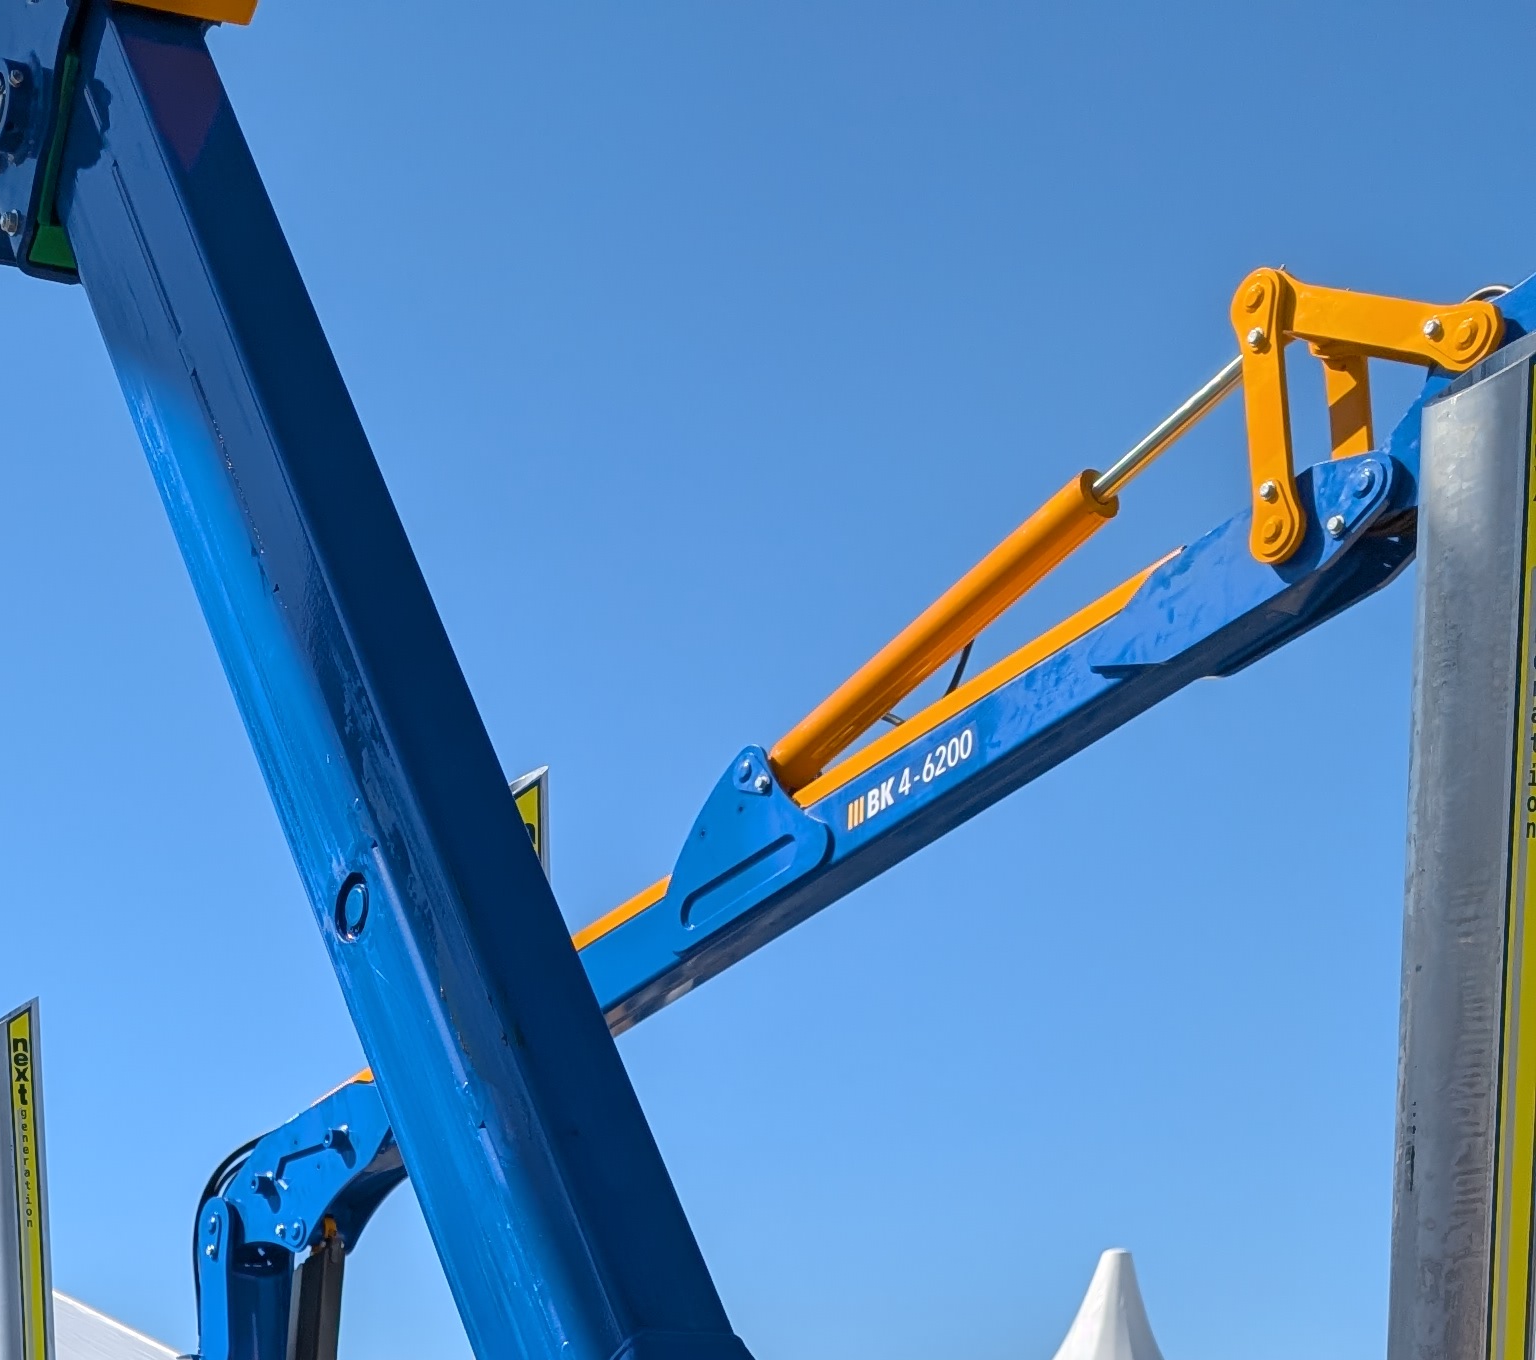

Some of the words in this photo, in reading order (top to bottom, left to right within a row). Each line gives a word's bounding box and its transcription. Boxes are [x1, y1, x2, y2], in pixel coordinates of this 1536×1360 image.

[867, 776, 895, 819] BK
[898, 729, 973, 796] 4-6200
[13, 1038, 29, 1105] next
[21, 1109, 33, 1228] generation
